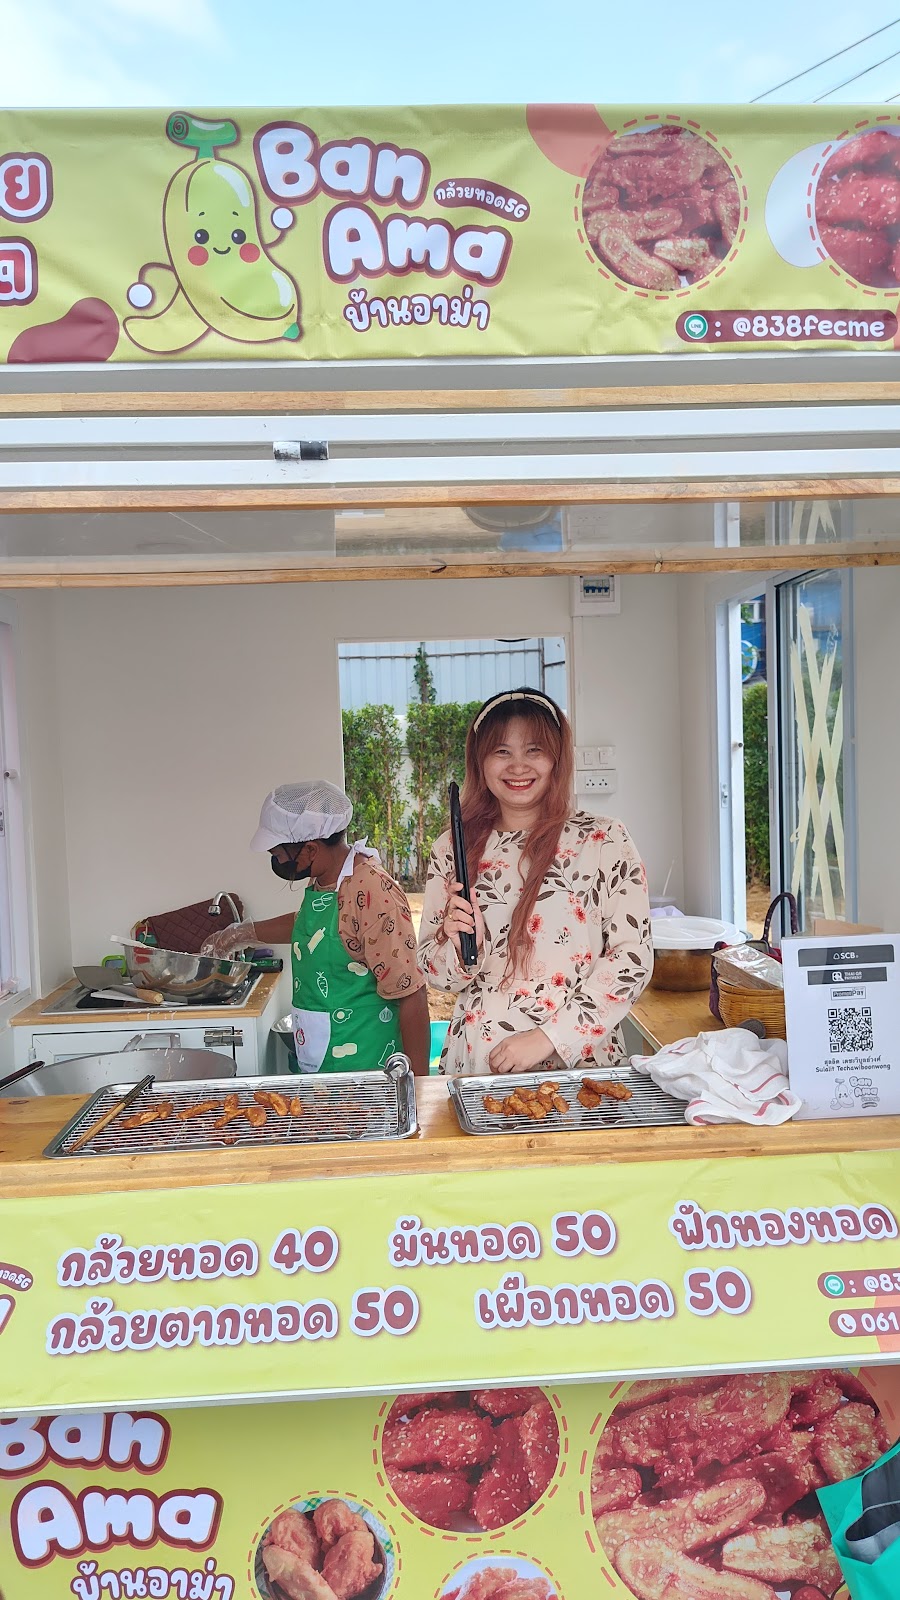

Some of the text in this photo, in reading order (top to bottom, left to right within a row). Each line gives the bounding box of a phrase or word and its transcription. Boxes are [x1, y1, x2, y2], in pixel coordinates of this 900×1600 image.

[257, 125, 426, 204] Ban
[326, 204, 509, 281] Ama
[344, 286, 490, 331] บ้านอาม่า
[733, 315, 885, 337] @838fecme
[840, 951, 856, 960] SCB
[392, 1213, 612, 1262] มันทอด 50
[672, 1204, 893, 1246] ฟักทองทอด
[61, 1230, 334, 1282] กล้วยทอด 40
[50, 1300, 333, 1350] กล้วยตากทอด
[353, 1289, 414, 1331] 50
[478, 1270, 747, 1324] เผือกทอด 50
[860, 1311, 900, 1333] 061
[16, 1484, 219, 1562] Ama
